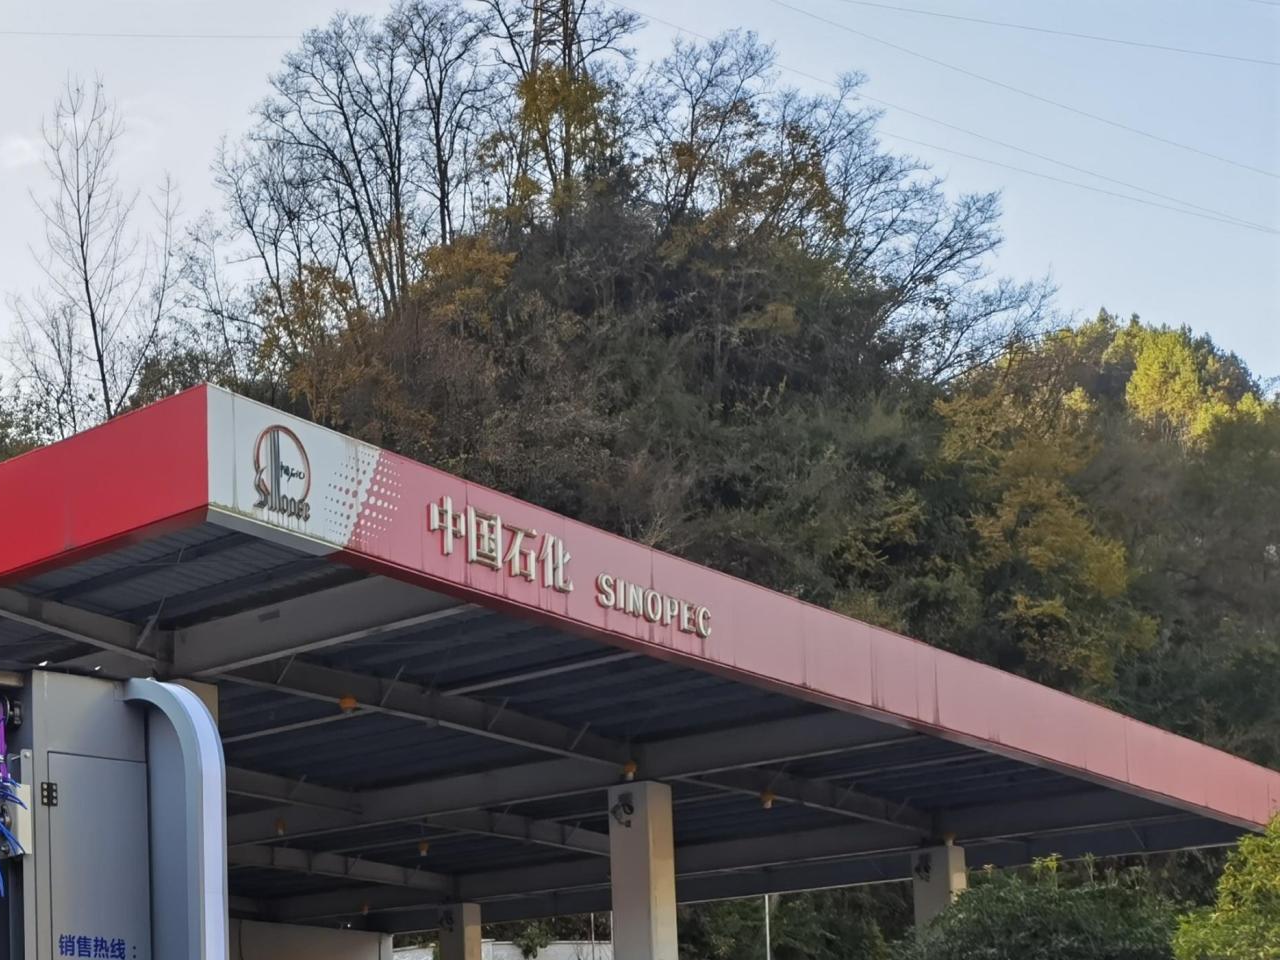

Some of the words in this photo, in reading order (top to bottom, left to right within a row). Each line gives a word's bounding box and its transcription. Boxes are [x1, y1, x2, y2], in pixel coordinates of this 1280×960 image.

[427, 495, 574, 593] 中国石化
[596, 571, 712, 639] SINOPEC
